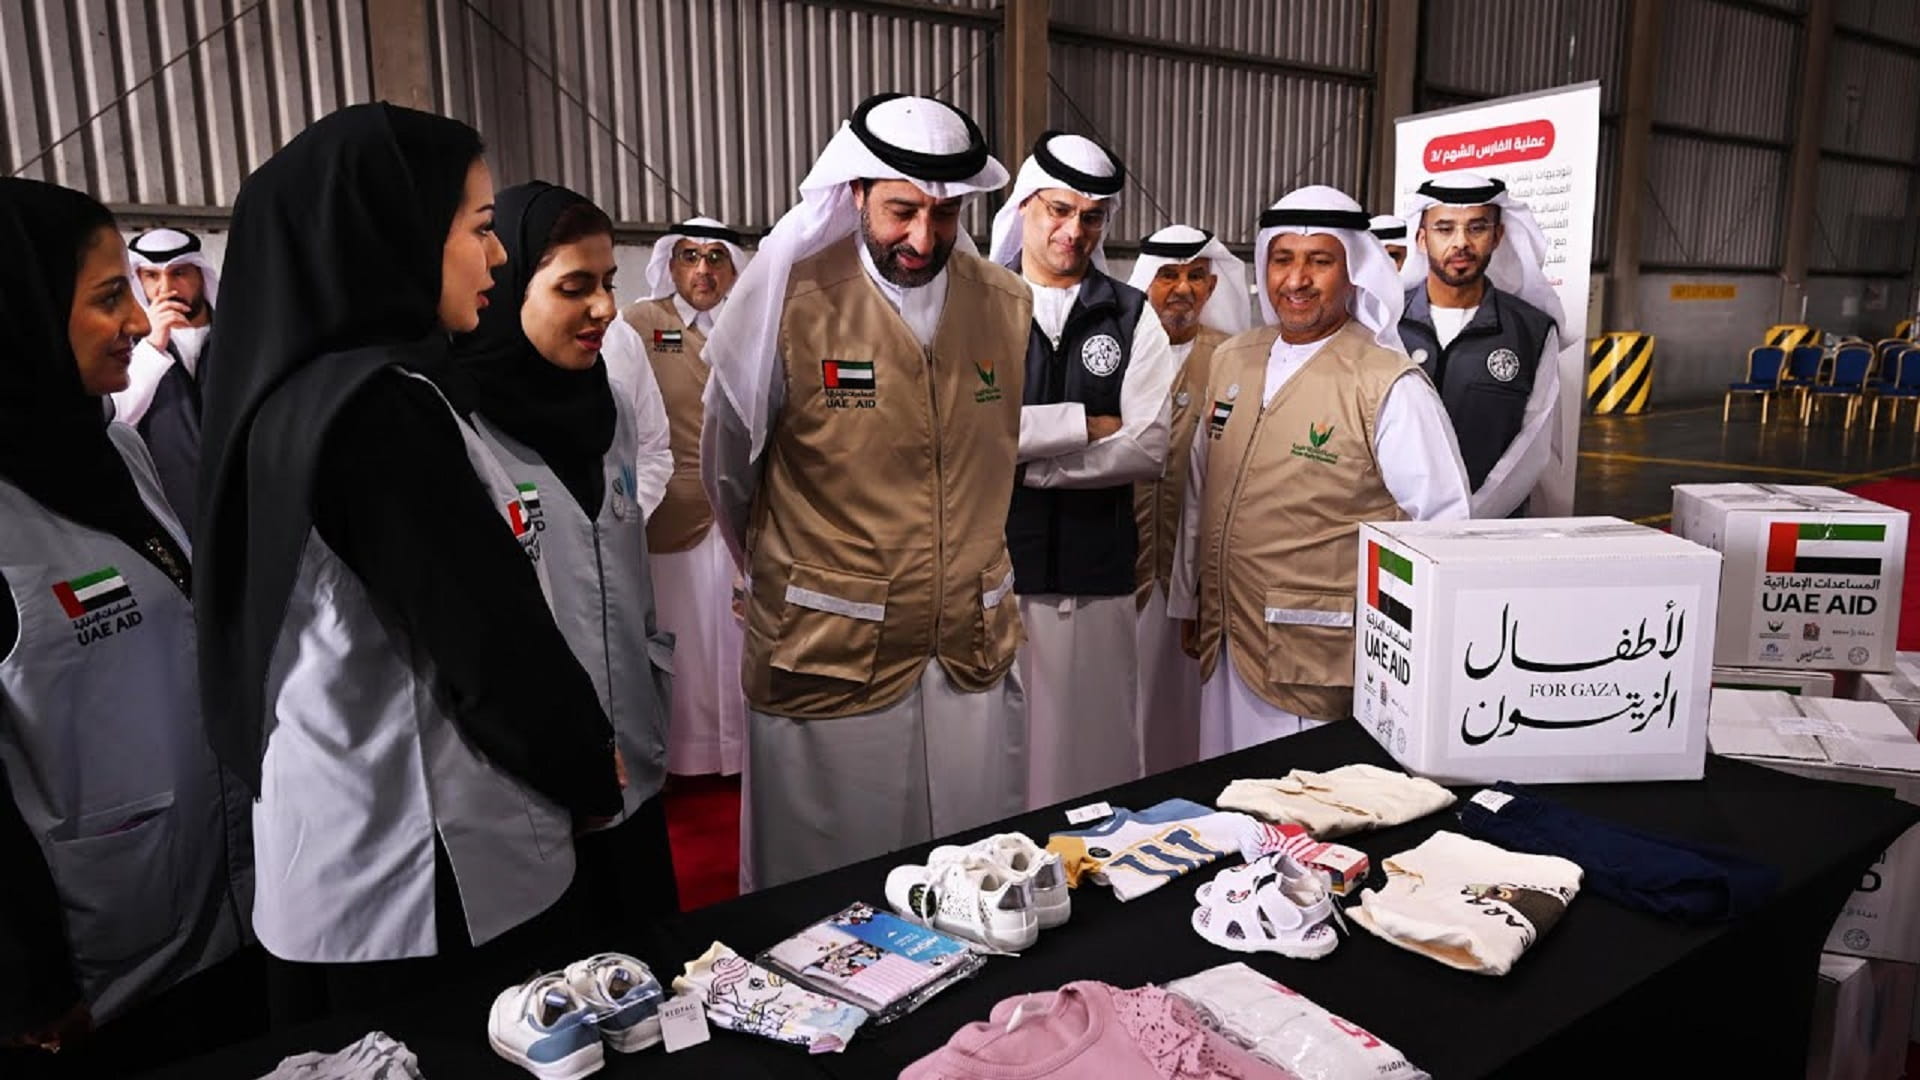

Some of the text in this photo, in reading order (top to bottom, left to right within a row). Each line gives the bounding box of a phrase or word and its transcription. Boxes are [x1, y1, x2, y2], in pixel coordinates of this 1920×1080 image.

[1442, 143, 1475, 165] الشهم
[1476, 138, 1512, 159] الفارس
[1514, 135, 1546, 152] عملية
[855, 399, 876, 409] AID
[1763, 575, 1881, 591] المساعدات الإماراتية
[1762, 592, 1878, 615] UAE AID
[77, 610, 143, 646] UAE AID
[1464, 600, 1686, 681] لأطفال
[1365, 629, 1411, 686] UAE AID
[1529, 682, 1621, 697] FOR GAZA
[1461, 670, 1678, 746] الزيتون
